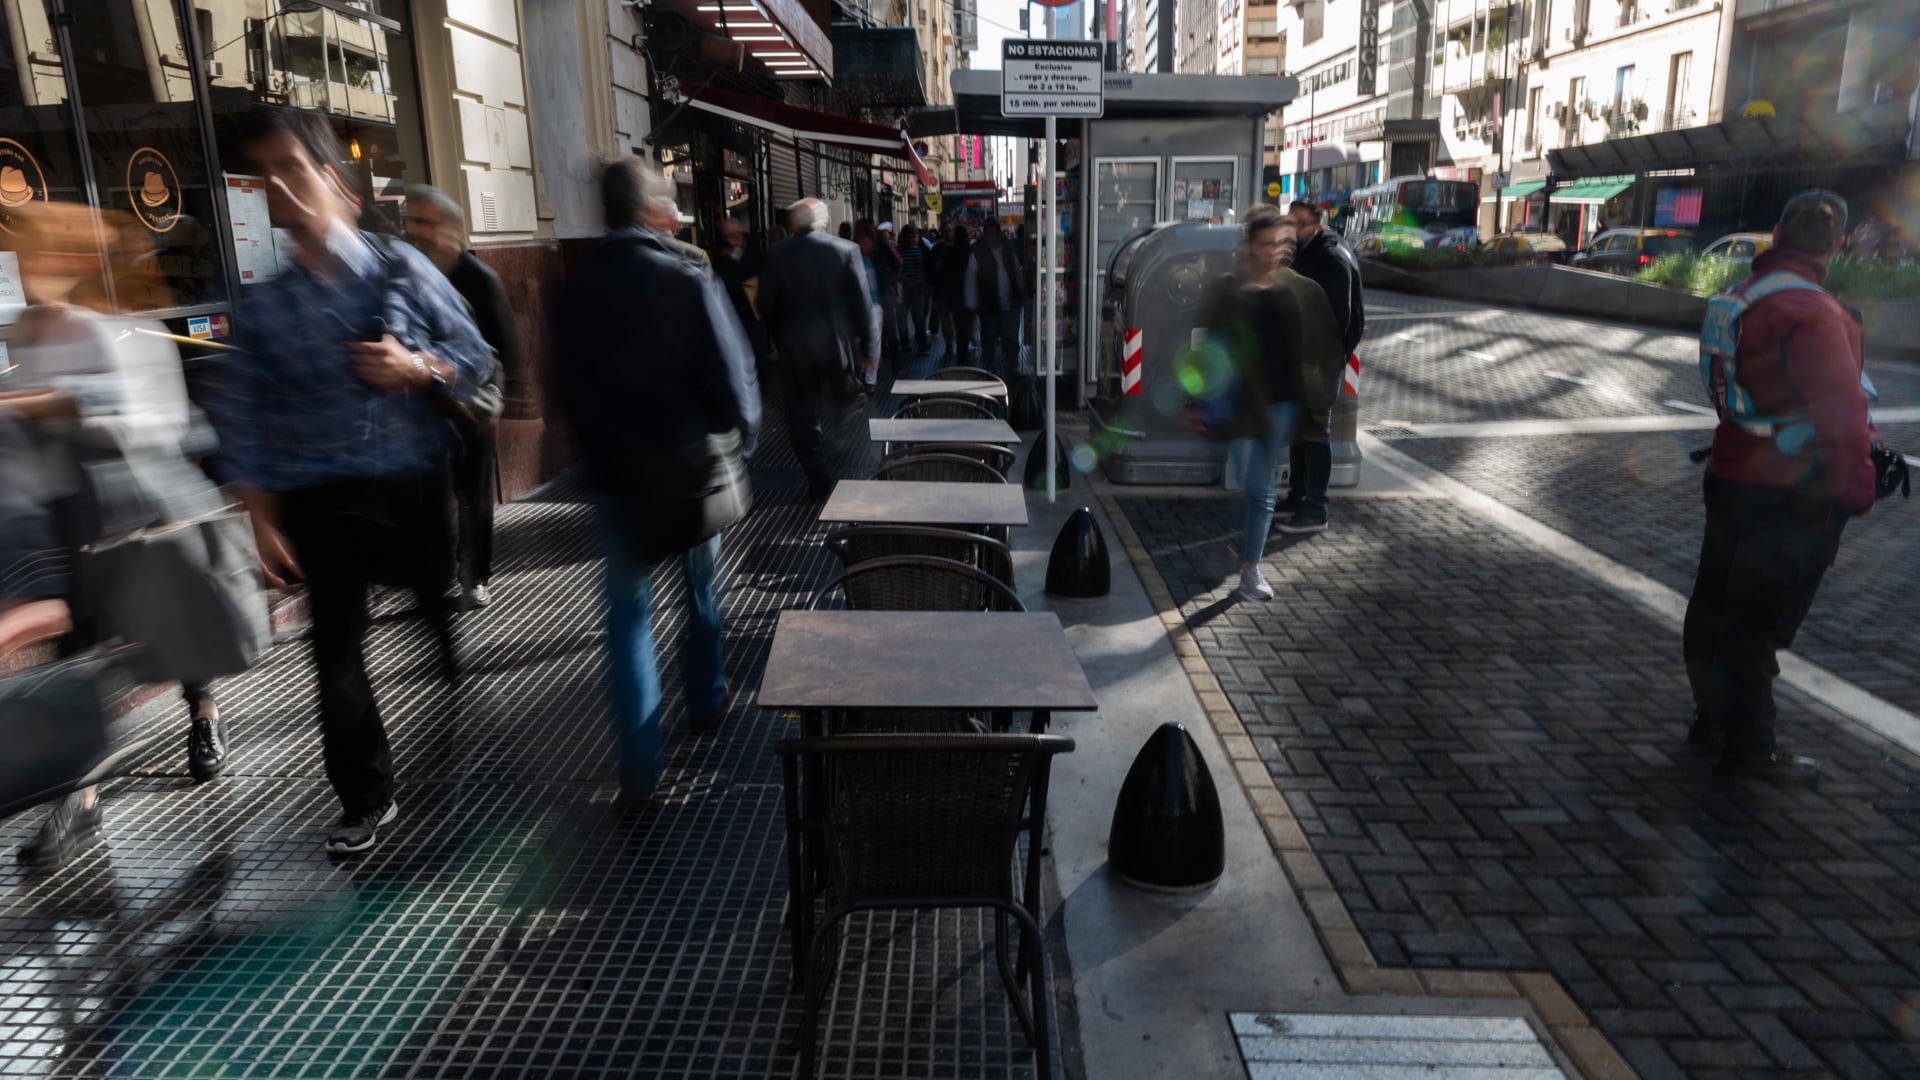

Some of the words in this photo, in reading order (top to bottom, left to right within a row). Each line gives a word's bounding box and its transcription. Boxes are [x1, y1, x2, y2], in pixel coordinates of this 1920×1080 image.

[1361, 0, 1377, 81] LORCA
[1008, 44, 1025, 55] NO
[1028, 45, 1097, 57] ESTACIONAR
[1034, 63, 1072, 71] Exclusivo
[1019, 74, 1042, 82] carga
[1009, 99, 1020, 108] 15
[1022, 99, 1041, 108] min.
[1043, 100, 1058, 109] por
[192, 324, 207, 333] VISA
